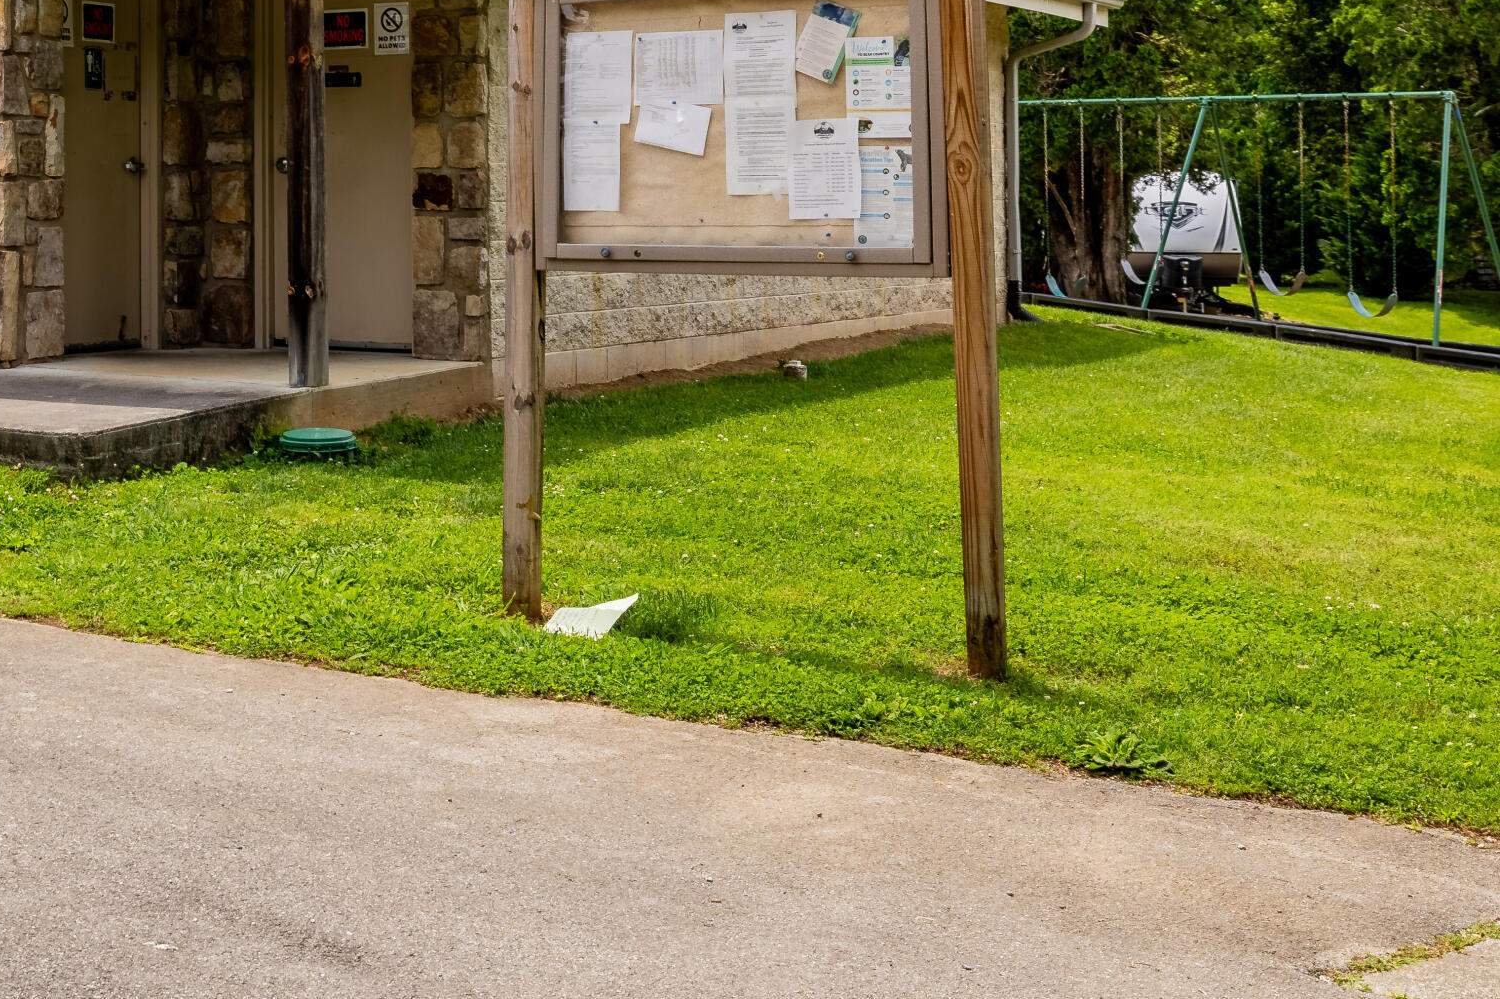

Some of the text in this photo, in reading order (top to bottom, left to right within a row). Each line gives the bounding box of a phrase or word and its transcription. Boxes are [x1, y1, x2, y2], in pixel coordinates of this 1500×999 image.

[336, 15, 351, 28] NO
[324, 28, 365, 44] SMOKING
[378, 42, 406, 50] ALLOWED
